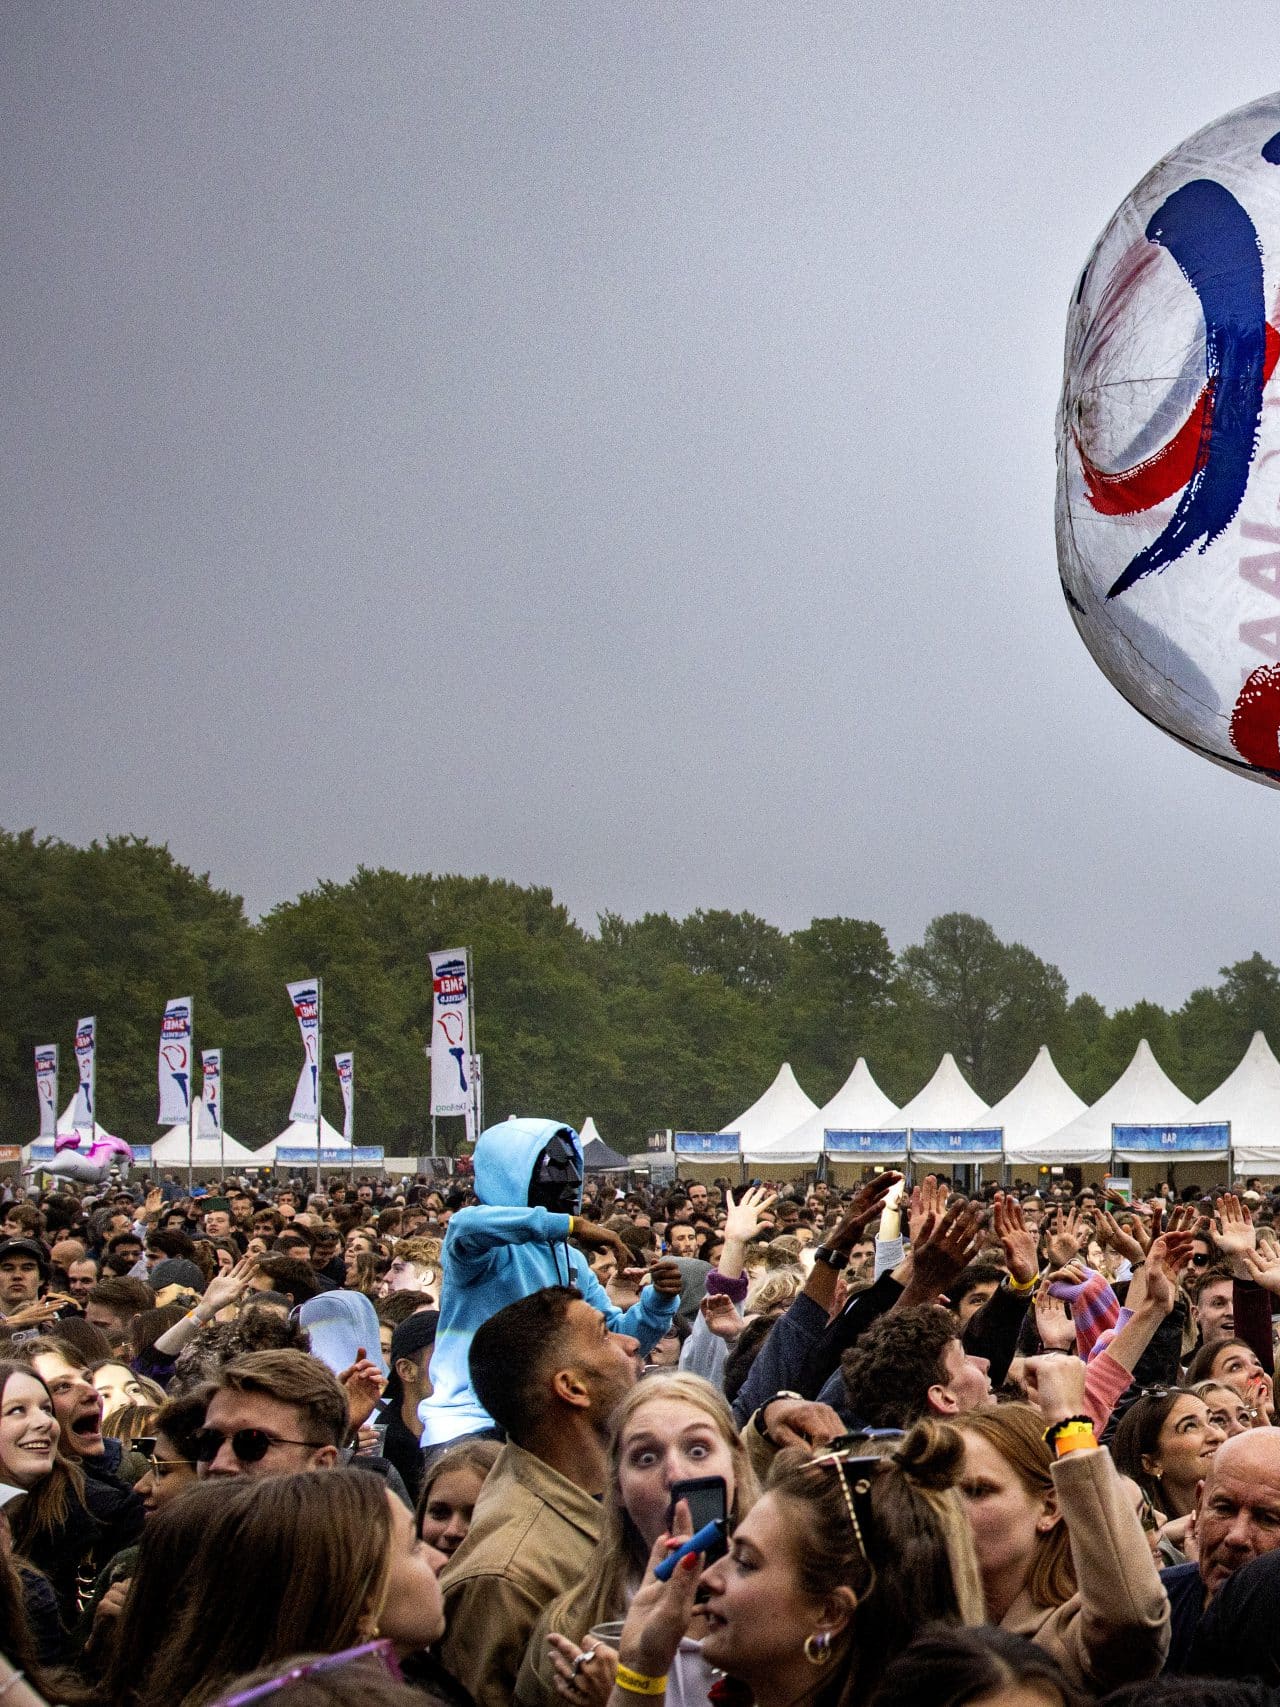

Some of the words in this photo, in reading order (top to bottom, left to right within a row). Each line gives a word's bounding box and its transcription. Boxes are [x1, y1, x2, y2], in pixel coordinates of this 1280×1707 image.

[859, 1136, 871, 1146] BAR
[949, 1136, 962, 1146] BAR
[1162, 1133, 1177, 1144] BAR
